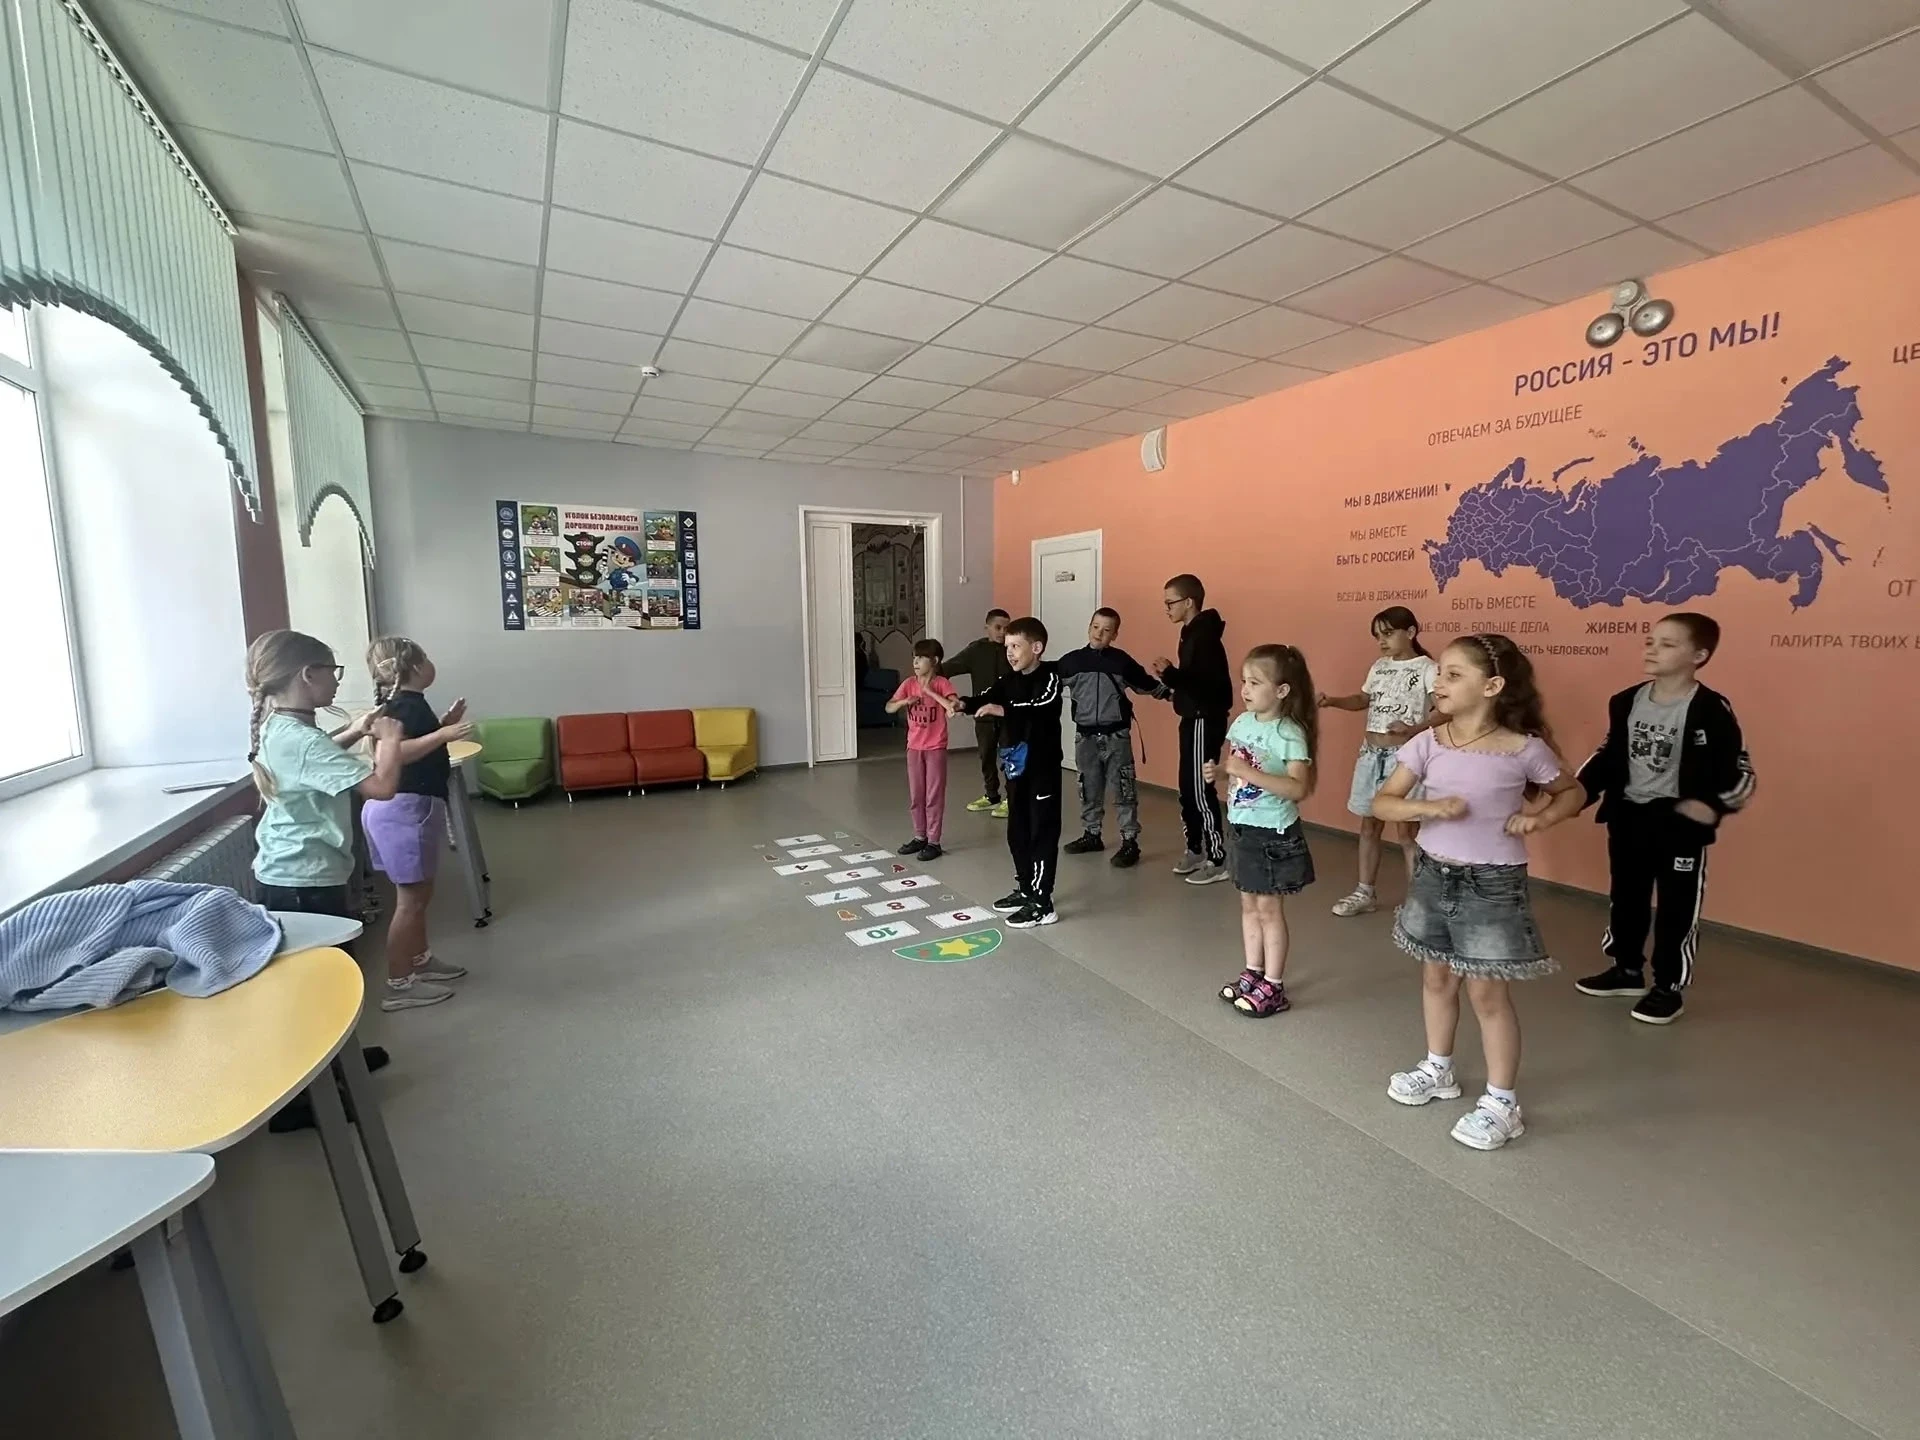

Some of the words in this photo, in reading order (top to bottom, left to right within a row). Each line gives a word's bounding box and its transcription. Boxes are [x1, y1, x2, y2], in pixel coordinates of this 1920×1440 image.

[1514, 352, 1613, 397] РОССИЯ
[1642, 332, 1698, 367] ЭТО
[1708, 311, 1780, 352] МЫ!
[1427, 421, 1491, 447] ОТВЕЧАЕМ
[1494, 418, 1511, 434] ЗА
[1516, 404, 1584, 430] БУДУЩЕЕ
[1344, 495, 1361, 508] МЫ
[1364, 494, 1371, 506] В
[1372, 484, 1439, 506] ДВИЖЕНИИ!
[565, 511, 590, 520] УГОЛОК
[590, 513, 639, 522] БЕЗОПАСНОСТИ
[564, 522, 605, 531] ДОРОЖНОГО
[605, 524, 640, 532] ДВИЖЕНИЯ
[1349, 530, 1366, 541] МЫ
[1369, 525, 1407, 540] ВМЕСТЕ
[1336, 554, 1360, 566] БЫТЬ
[1362, 553, 1368, 564] С
[1370, 547, 1415, 563] РОССИЕЙ
[1887, 579, 1918, 598] ОТ
[1336, 591, 1367, 602] ВСЕГДА
[1368, 591, 1375, 601] В
[1376, 589, 1428, 602] ДВИЖЕНИИ
[1451, 598, 1483, 611] БЫТЬ
[1486, 595, 1537, 610] ВМЕСТЕ
[1435, 621, 1461, 633] СЛОВ
[1471, 621, 1517, 633] БОЛЬШЕ
[1519, 621, 1549, 634] ДЕЛА
[1584, 621, 1637, 634] ЖИВЕМ
[1641, 621, 1651, 634] В
[1769, 634, 1844, 648] ПАЛИТРА
[1848, 634, 1908, 649] ТВОИХ
[1546, 644, 1609, 656] ЧЕЛОВЕКОМ
[846, 871, 861, 879] 5
[833, 892, 849, 900] 7
[886, 901, 906, 911] 8
[866, 926, 898, 940] 10
